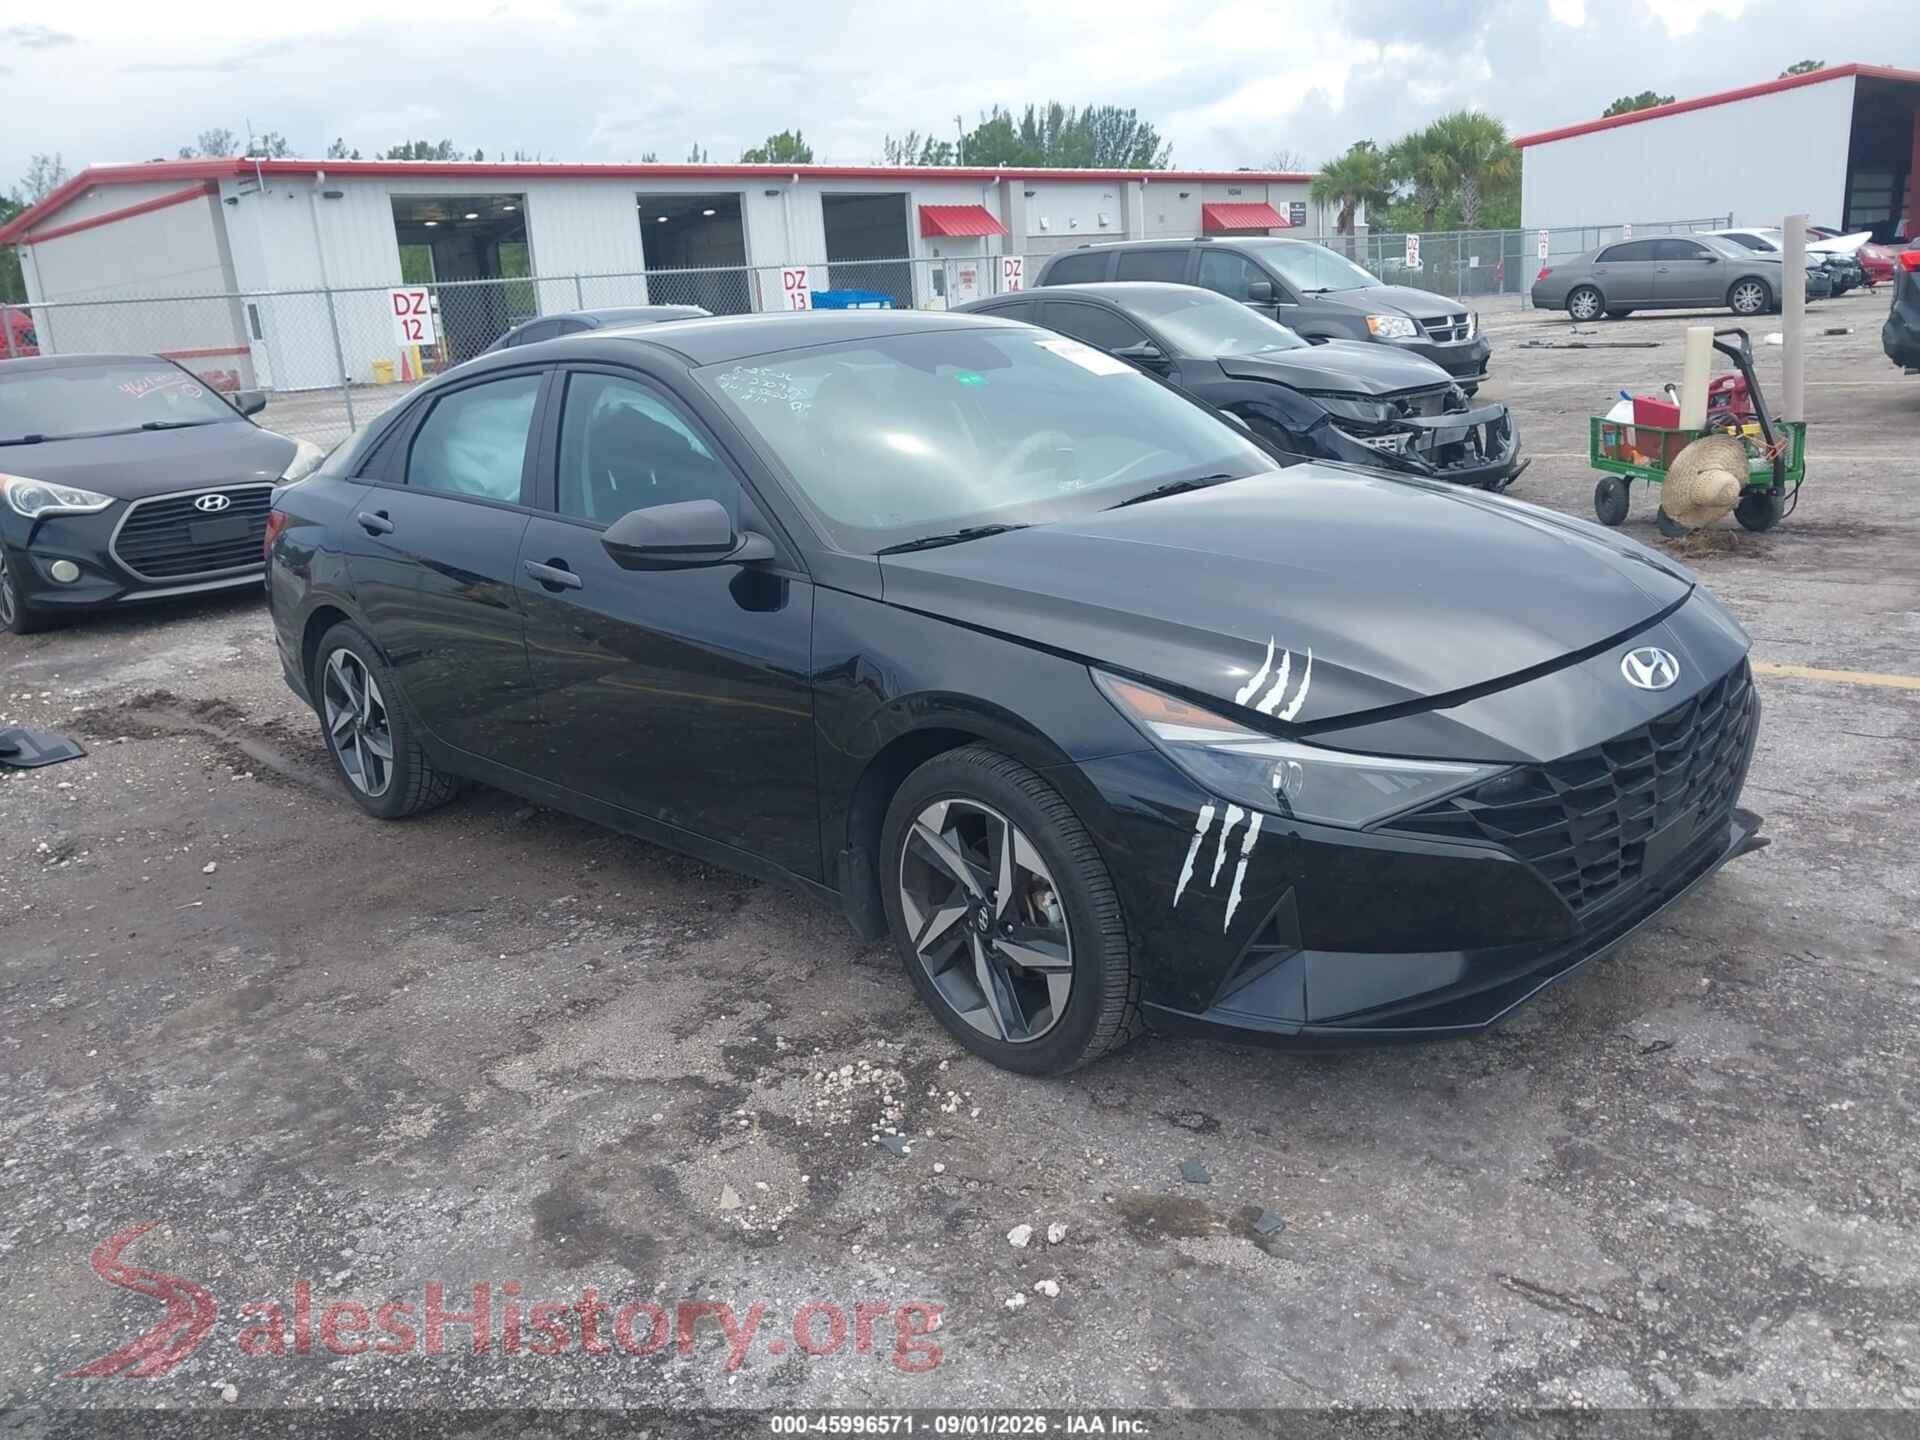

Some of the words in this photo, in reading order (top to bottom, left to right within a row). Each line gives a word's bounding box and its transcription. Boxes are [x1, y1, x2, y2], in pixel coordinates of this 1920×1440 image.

[1004, 260, 1021, 277] DZ
[784, 270, 807, 290] DZ
[393, 292, 427, 316] DZ
[791, 293, 806, 311] 13
[402, 319, 424, 341] 12
